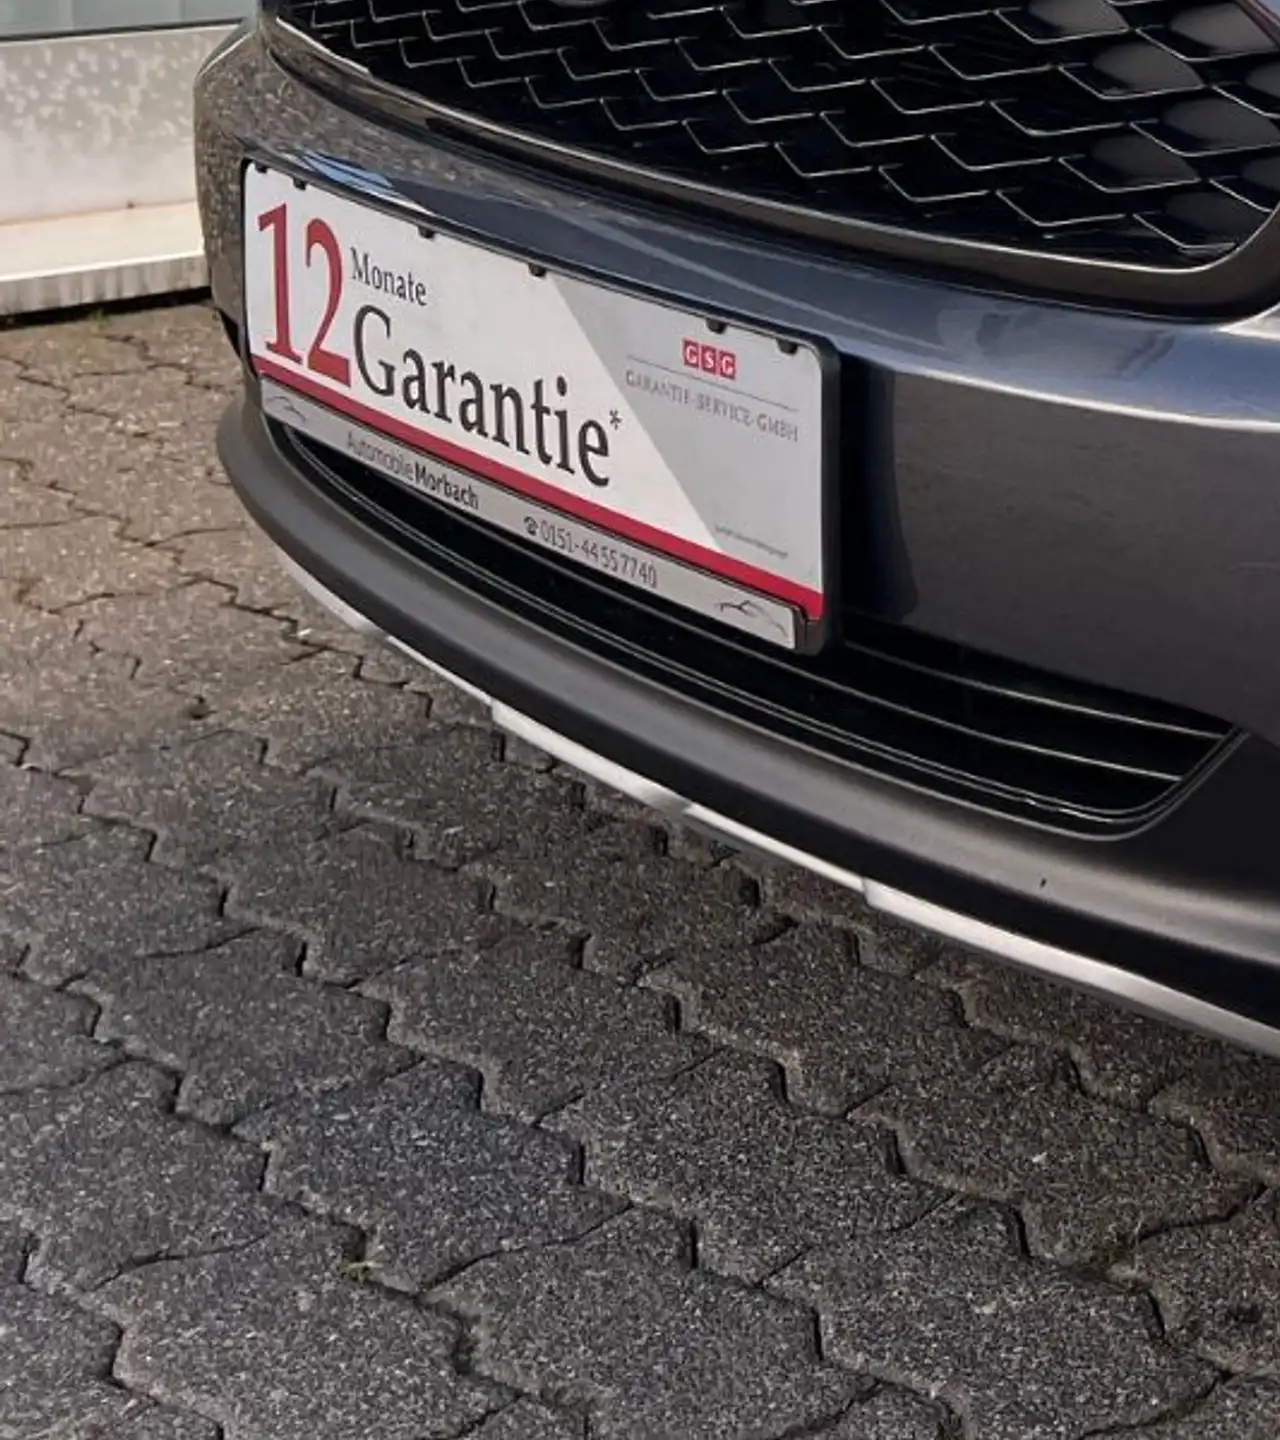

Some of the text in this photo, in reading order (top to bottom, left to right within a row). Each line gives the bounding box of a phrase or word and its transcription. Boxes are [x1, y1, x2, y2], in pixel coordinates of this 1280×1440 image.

[257, 202, 351, 388] 12
[349, 246, 427, 307] Monate
[683, 340, 736, 379] GSG
